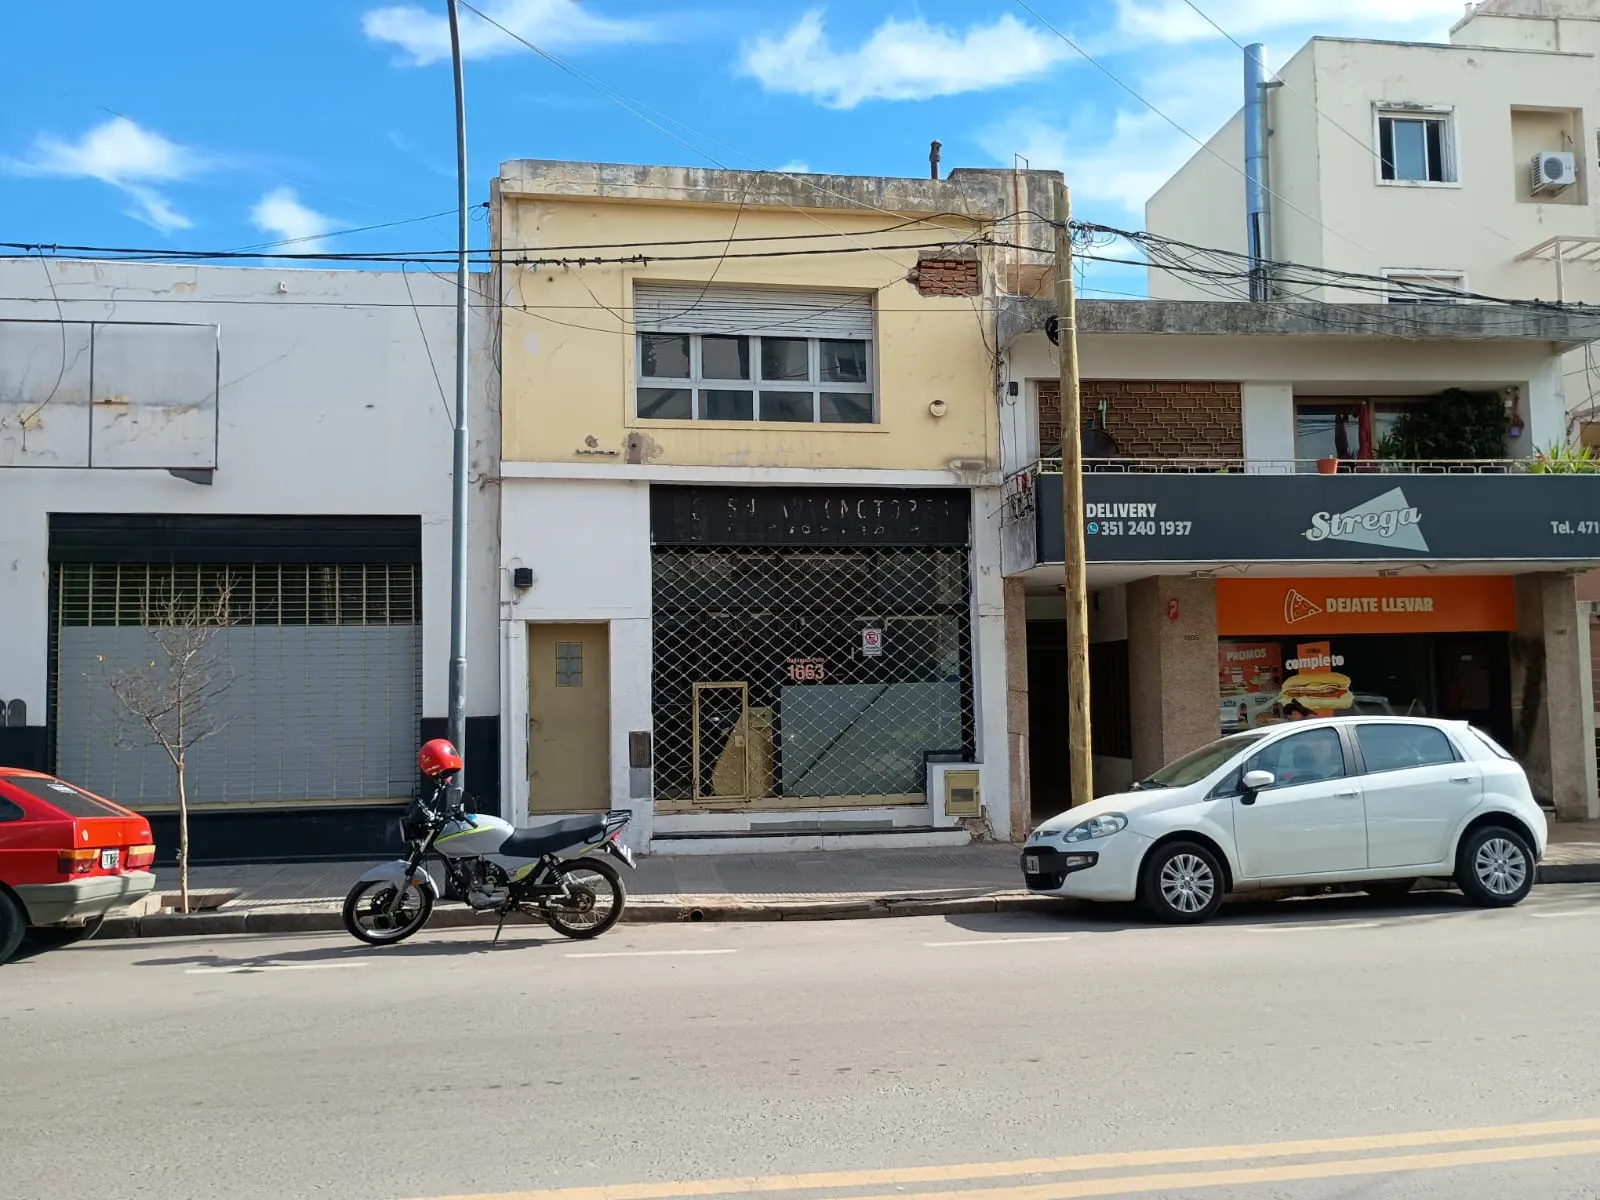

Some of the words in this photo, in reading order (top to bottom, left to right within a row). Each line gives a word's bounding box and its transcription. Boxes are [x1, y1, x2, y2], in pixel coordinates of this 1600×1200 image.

[1086, 503, 1157, 518] DELIVERY
[1101, 521, 1123, 536] 351
[1128, 521, 1156, 536] 240
[1160, 521, 1192, 536] 1937
[1300, 507, 1422, 541] Strega
[1550, 520, 1575, 534] Tel.
[1577, 520, 1599, 534] 471
[1326, 598, 1378, 612] DEJATE
[1382, 597, 1433, 611] LLEVAR
[1227, 648, 1266, 661] PROMOS
[1285, 653, 1345, 671] completo
[787, 664, 825, 680] 1663
